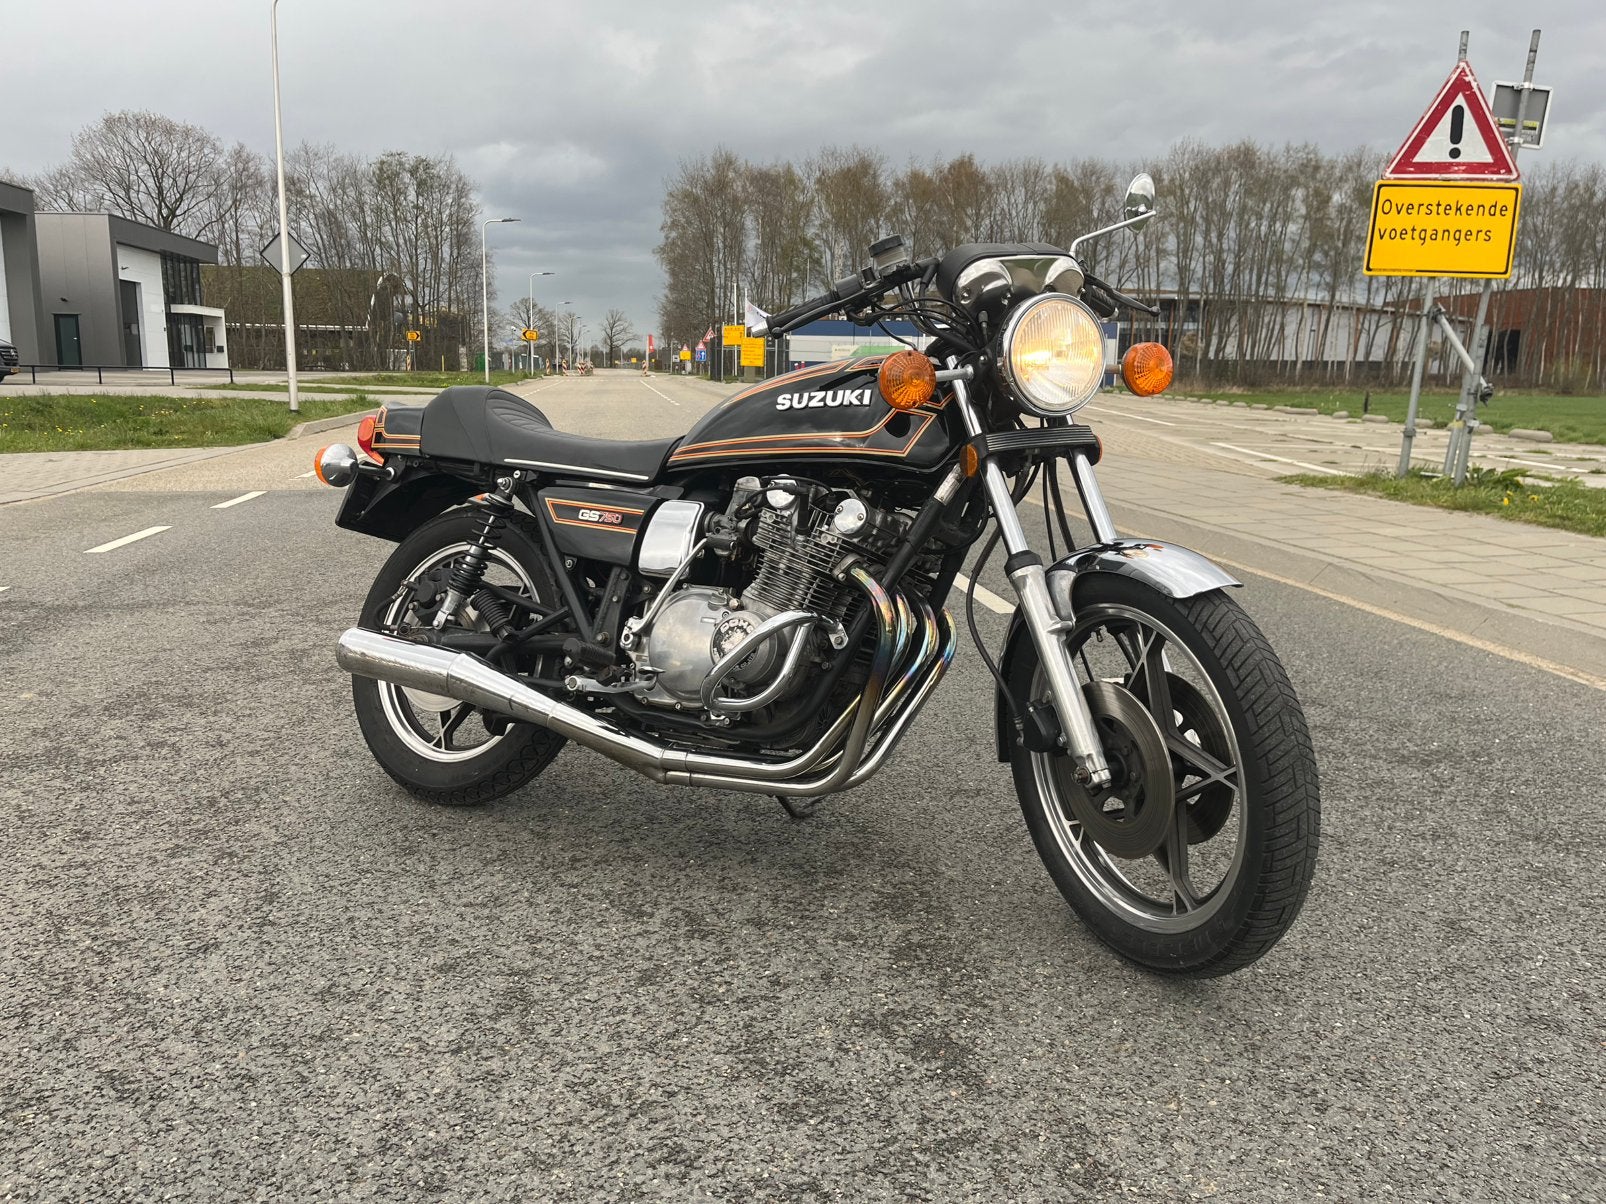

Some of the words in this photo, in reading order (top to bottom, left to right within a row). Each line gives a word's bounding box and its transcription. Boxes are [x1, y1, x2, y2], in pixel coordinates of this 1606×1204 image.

[1381, 198, 1508, 217] Overstekende
[1378, 225, 1492, 246] voetgangers
[775, 389, 872, 411] SUZUKI
[578, 509, 622, 524] GS750
